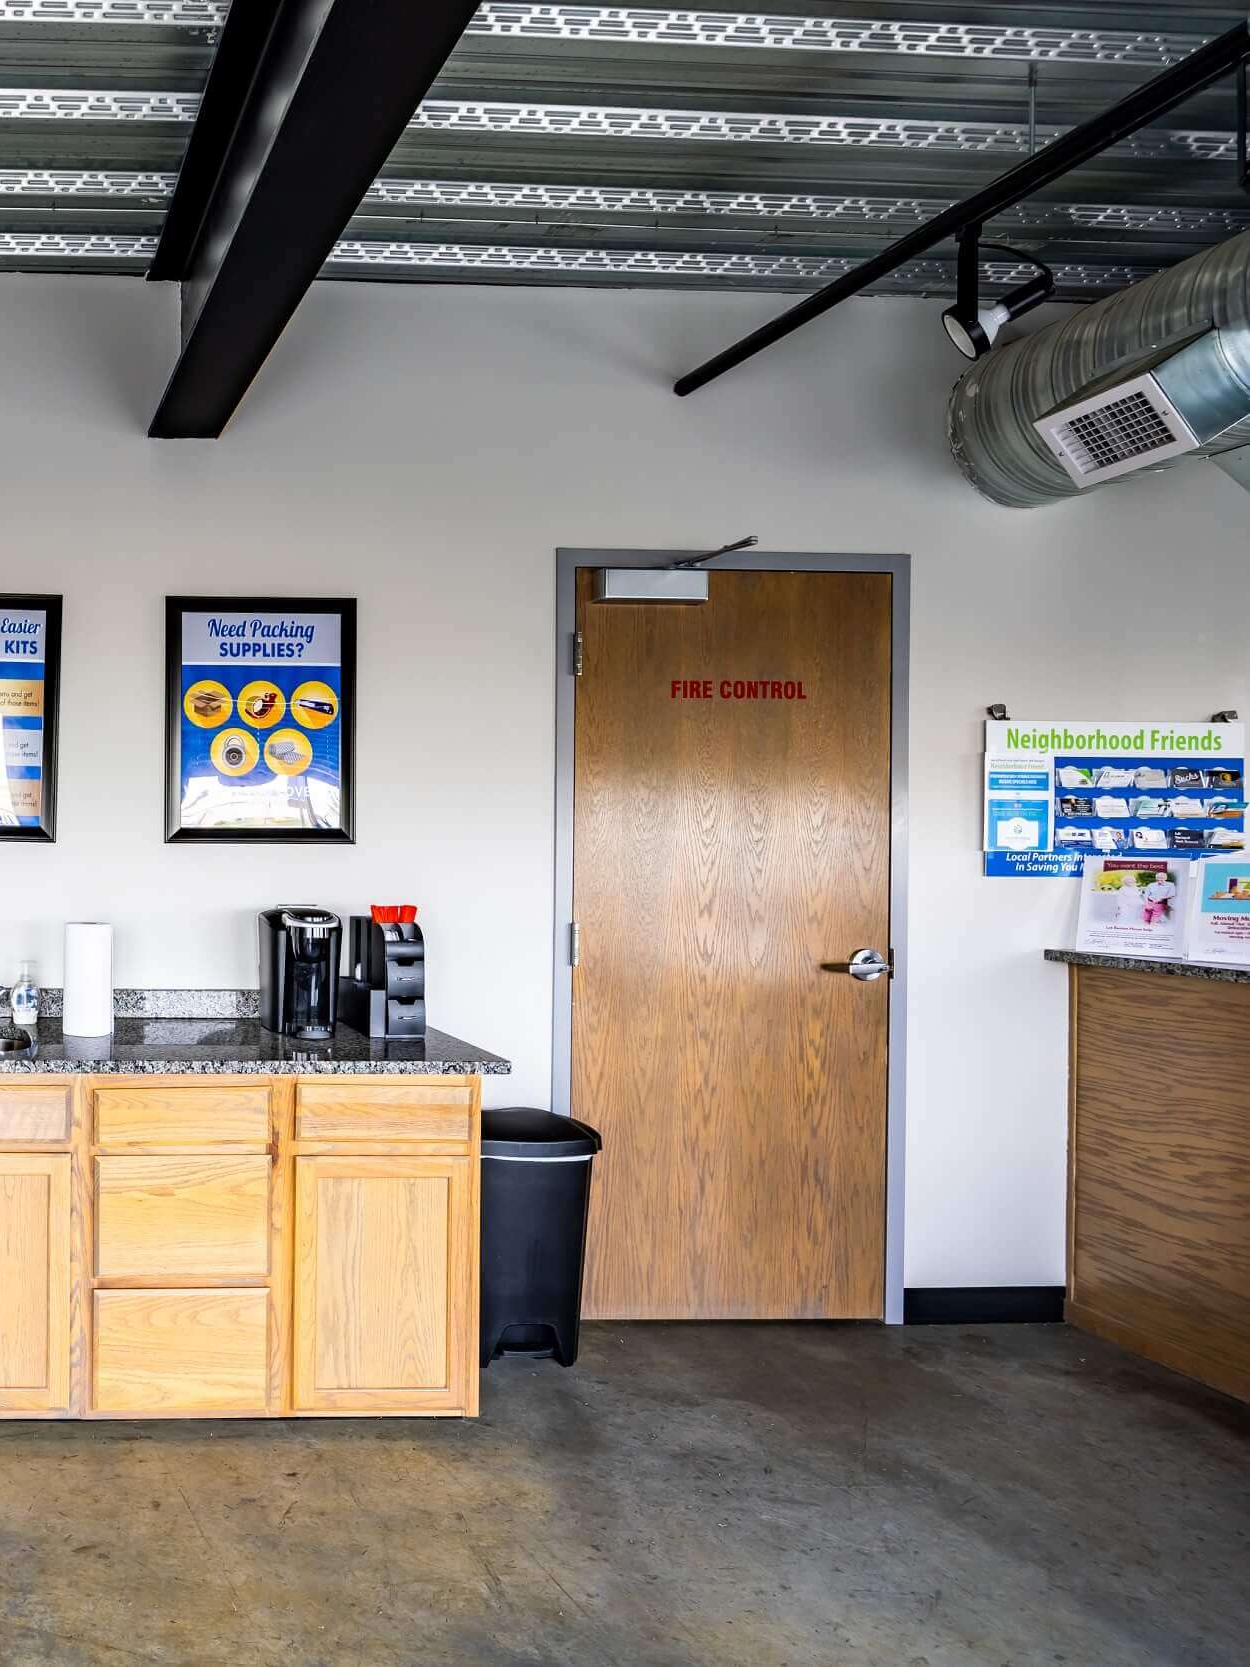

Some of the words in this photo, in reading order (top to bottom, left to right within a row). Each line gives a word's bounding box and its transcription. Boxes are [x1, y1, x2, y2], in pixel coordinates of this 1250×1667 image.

[0, 618, 41, 635] Easier
[208, 618, 246, 637] Need
[250, 620, 315, 644] Packing
[4, 639, 38, 654] KITS
[219, 642, 305, 658] SUPPLIES?
[23, 690, 33, 699] get
[670, 680, 713, 699] FIRE
[719, 680, 807, 700] CONTROL
[1006, 728, 1145, 754] Neighborhood
[1151, 729, 1222, 751] Friends
[1006, 852, 1031, 861] Local
[1032, 852, 1072, 862] Partners
[1015, 862, 1024, 871] In
[1027, 862, 1058, 873] Saving
[1060, 862, 1077, 871] You
